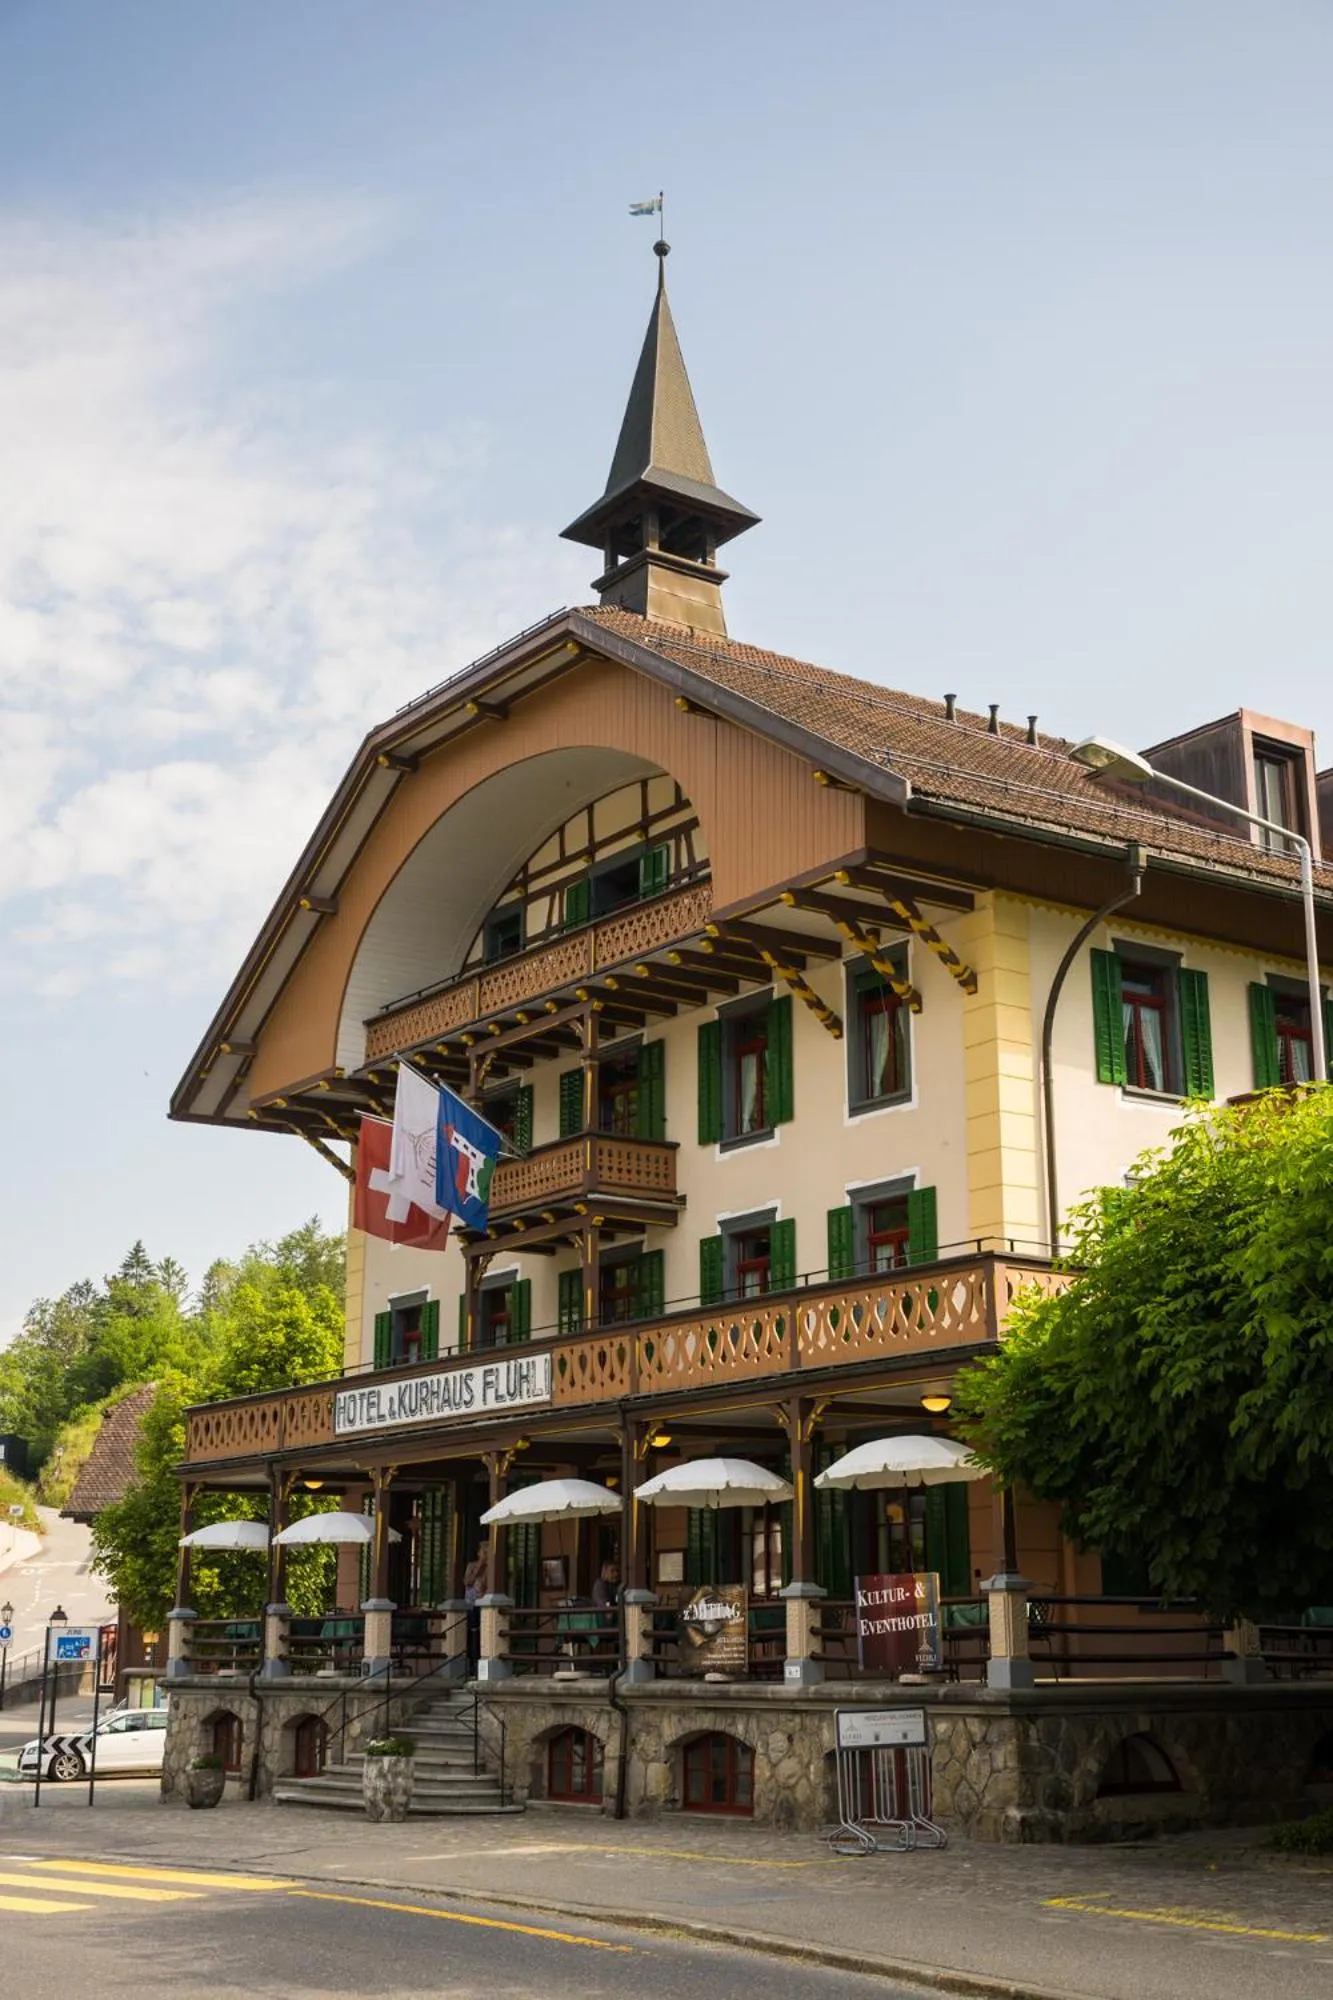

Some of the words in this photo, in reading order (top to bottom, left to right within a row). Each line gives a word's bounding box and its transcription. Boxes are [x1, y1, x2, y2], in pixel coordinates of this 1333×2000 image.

[336, 1389, 386, 1429] HOTEL
[387, 1396, 397, 1420] &
[399, 1372, 474, 1418] KURHAUS
[482, 1356, 550, 1407] FLÜHLI
[914, 1581, 925, 1599] &
